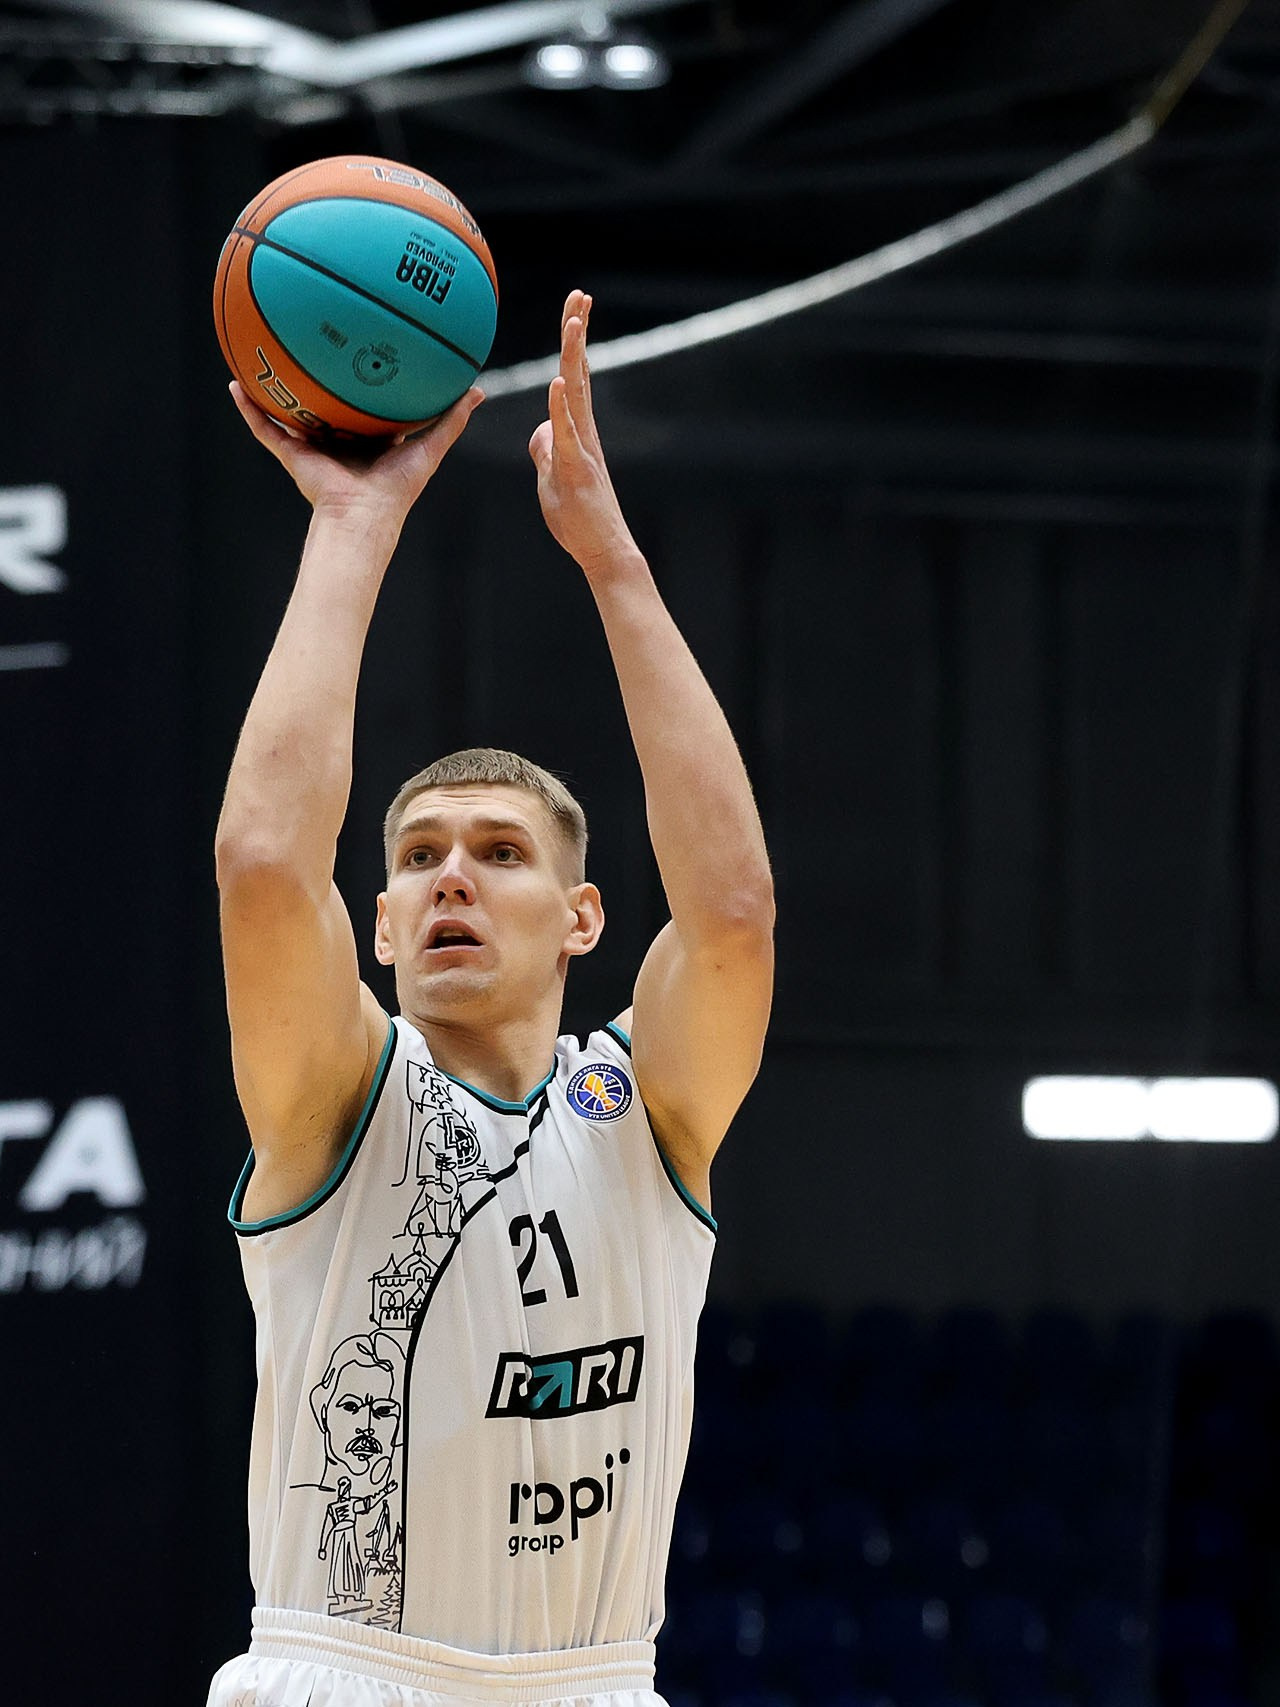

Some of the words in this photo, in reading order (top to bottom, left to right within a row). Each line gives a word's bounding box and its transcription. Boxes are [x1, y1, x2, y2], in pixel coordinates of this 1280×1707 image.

[395, 253, 452, 305] FIBA
[405, 240, 457, 277] APPROVED
[508, 1209, 580, 1307] 21
